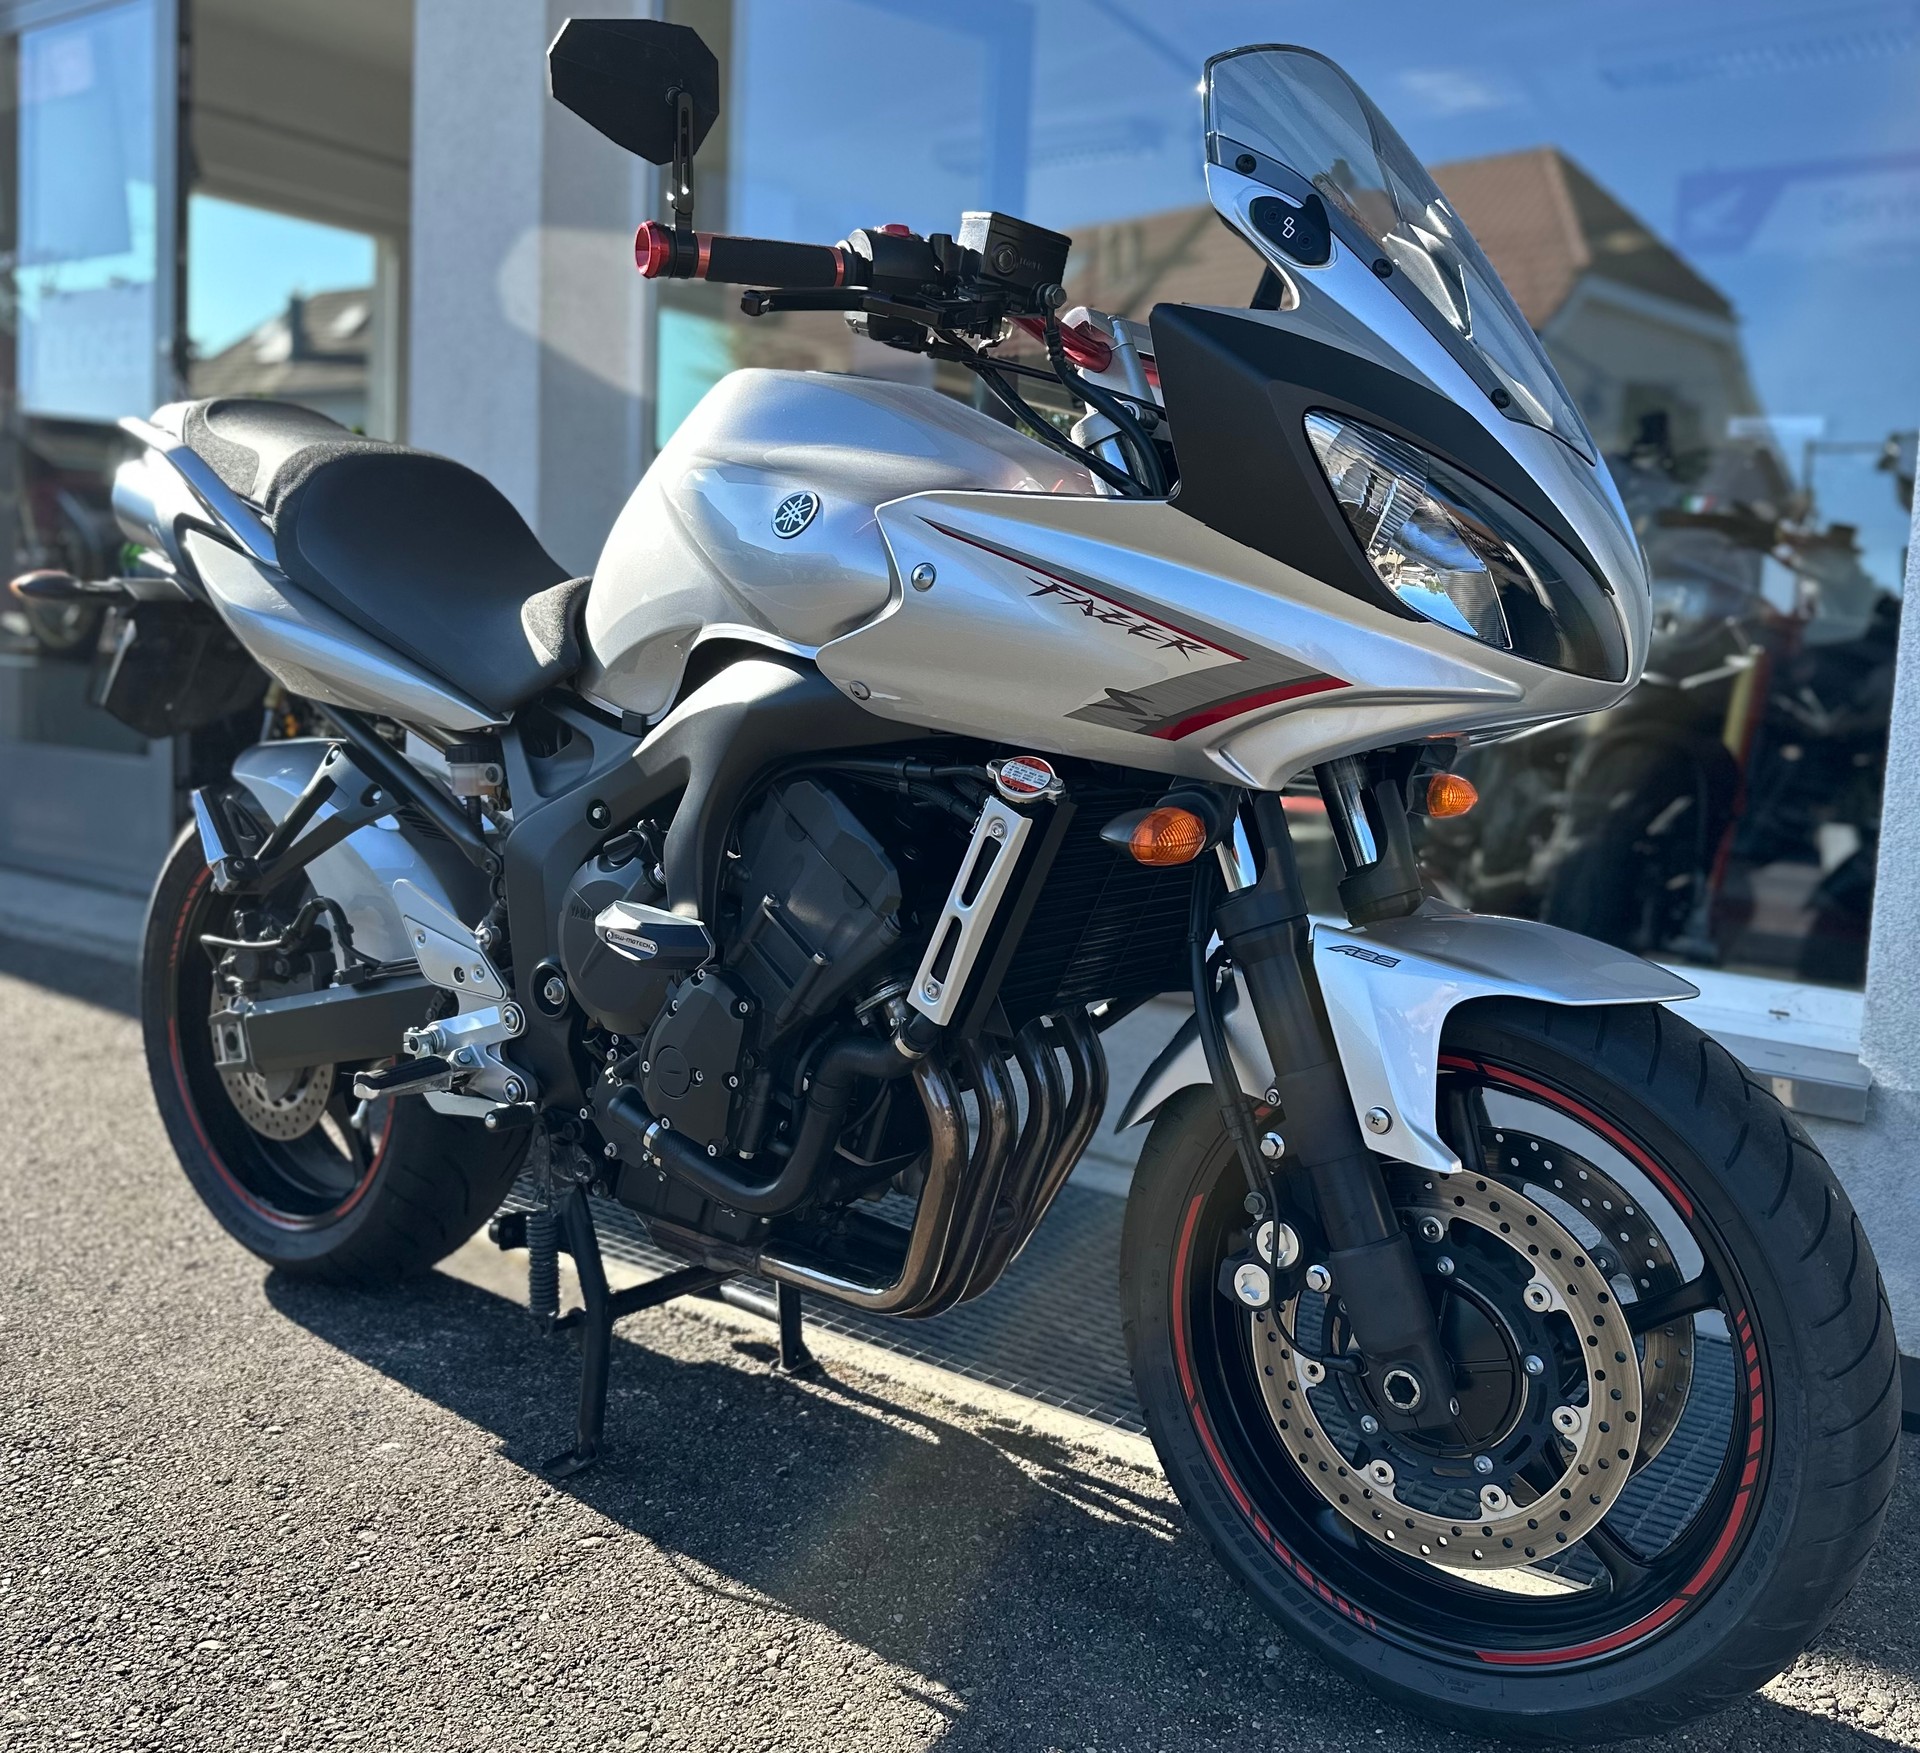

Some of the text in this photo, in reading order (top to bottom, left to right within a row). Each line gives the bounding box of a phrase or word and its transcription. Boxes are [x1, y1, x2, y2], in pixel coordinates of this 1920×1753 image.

[1025, 576, 1210, 661] FAZER
[1324, 945, 1402, 968] ABS
[1182, 1460, 1362, 1652] BRIDGESTONE
